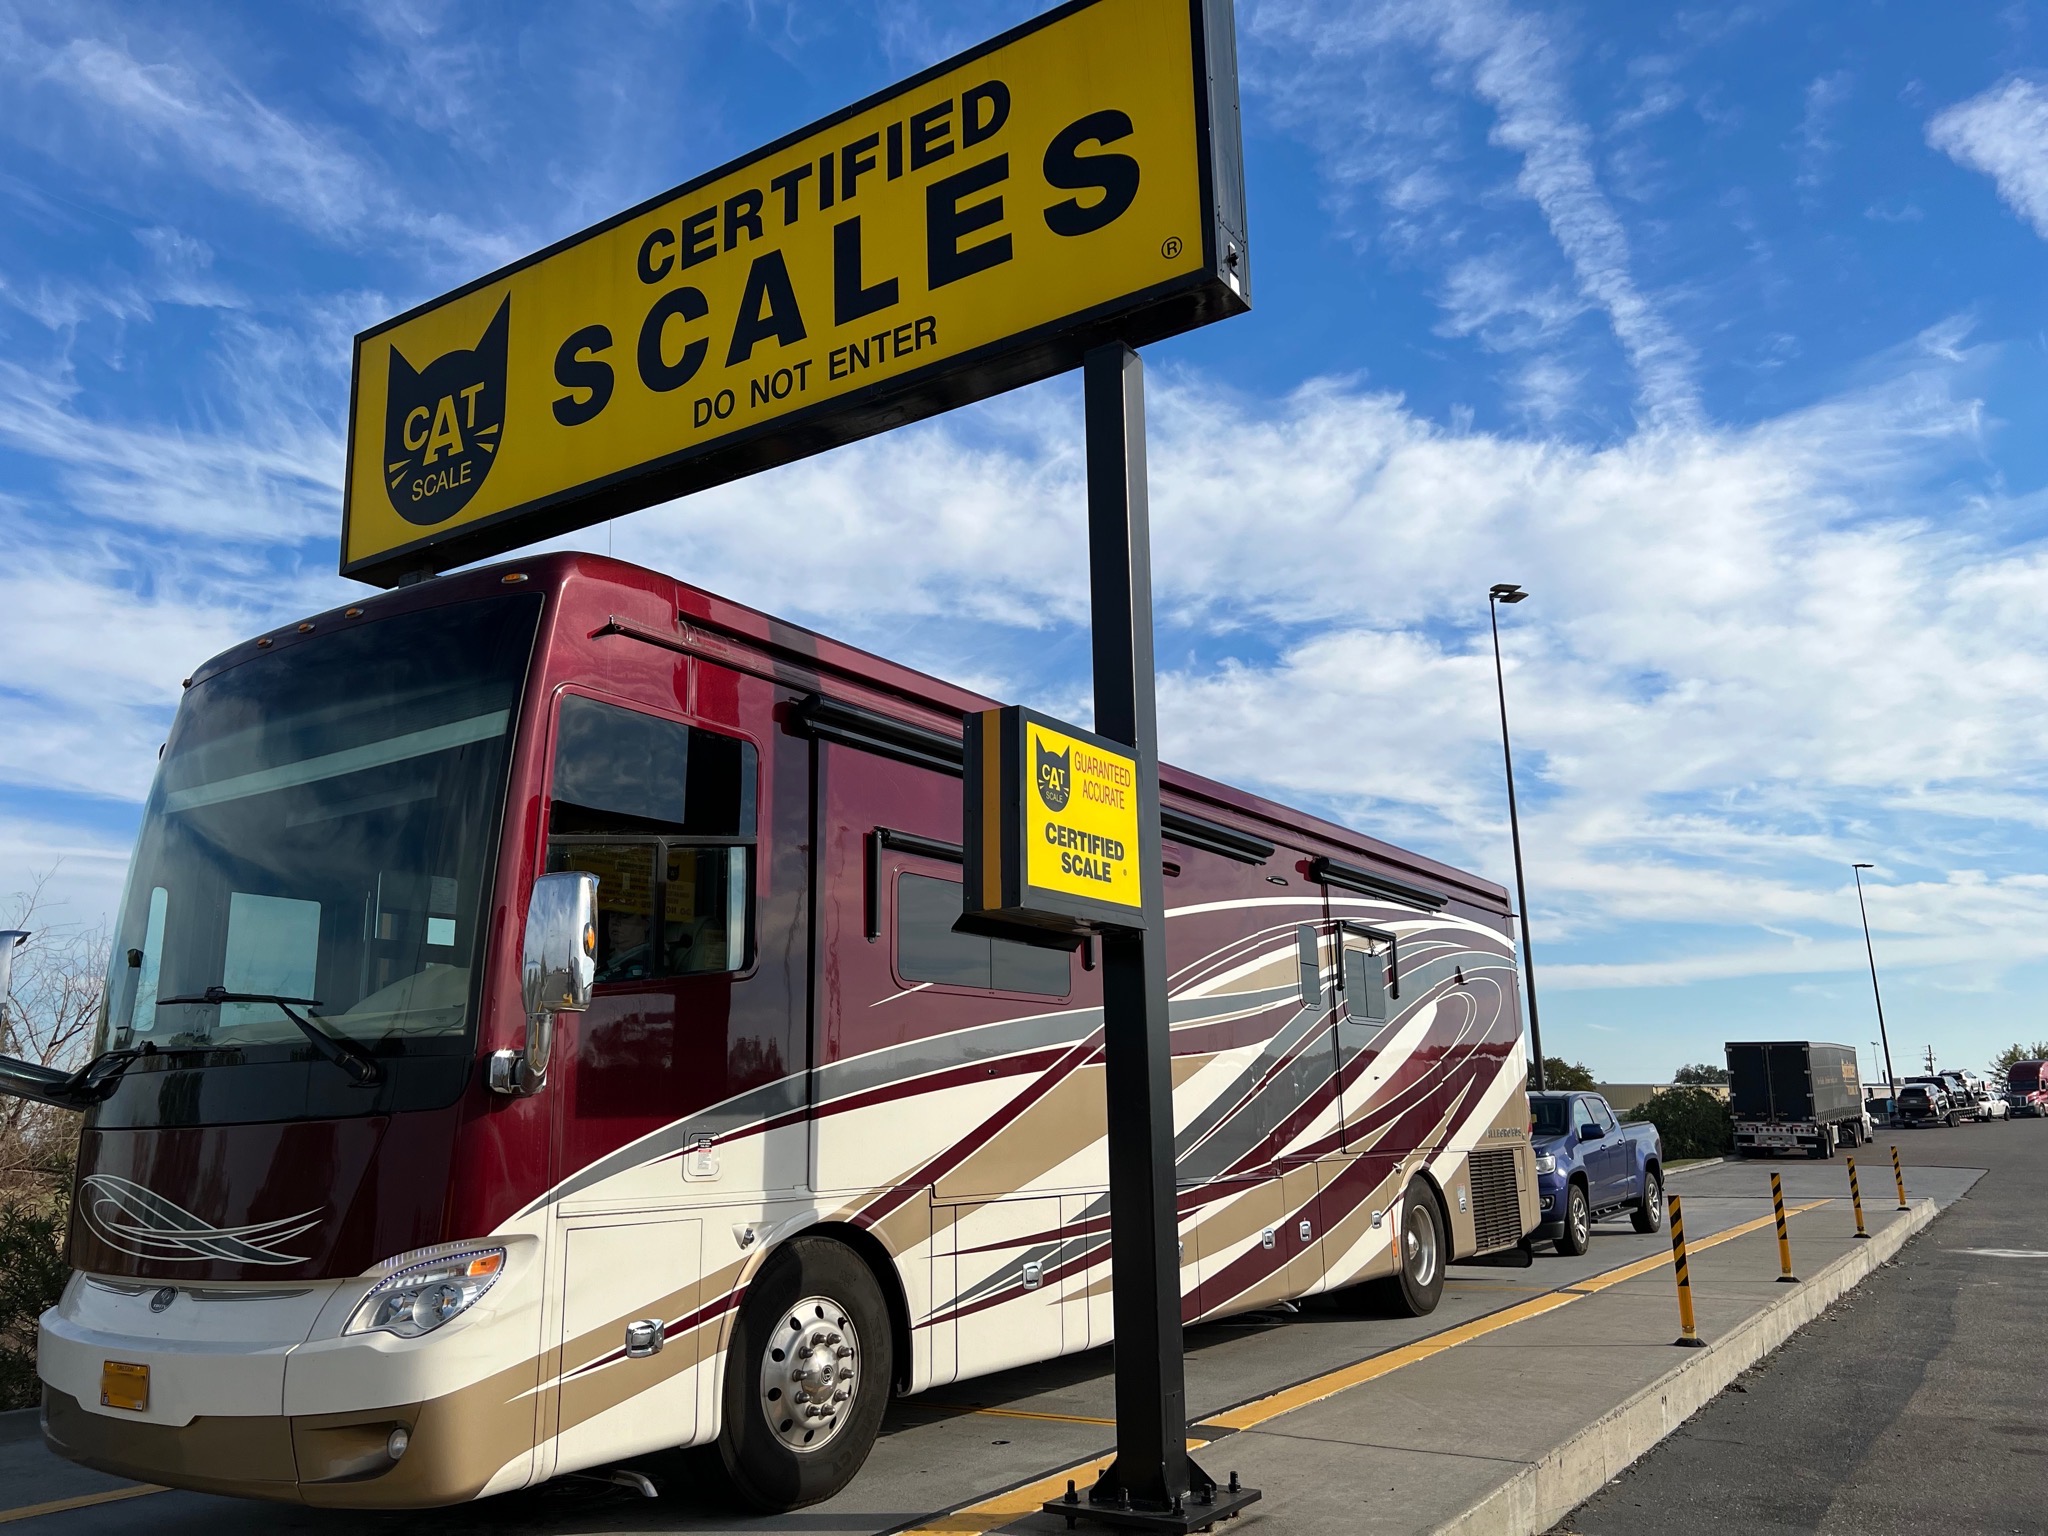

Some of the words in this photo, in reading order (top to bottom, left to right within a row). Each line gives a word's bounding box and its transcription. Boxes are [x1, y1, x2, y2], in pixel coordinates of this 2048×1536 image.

[637, 79, 1011, 285] CERTIFIED
[552, 109, 1141, 427] SCALES
[693, 389, 735, 429] DO
[750, 360, 813, 409] NOT
[828, 315, 938, 381] ENTER
[403, 381, 485, 466] CAT
[411, 461, 471, 502] SCALE
[1042, 764, 1065, 791] CAT
[1074, 751, 1131, 788] GUARANTEED
[1045, 790, 1064, 804] SCALE
[1082, 778, 1125, 810] ACCURATE
[1045, 822, 1125, 861] CERTIFIED
[1061, 852, 1112, 883] SCALE
